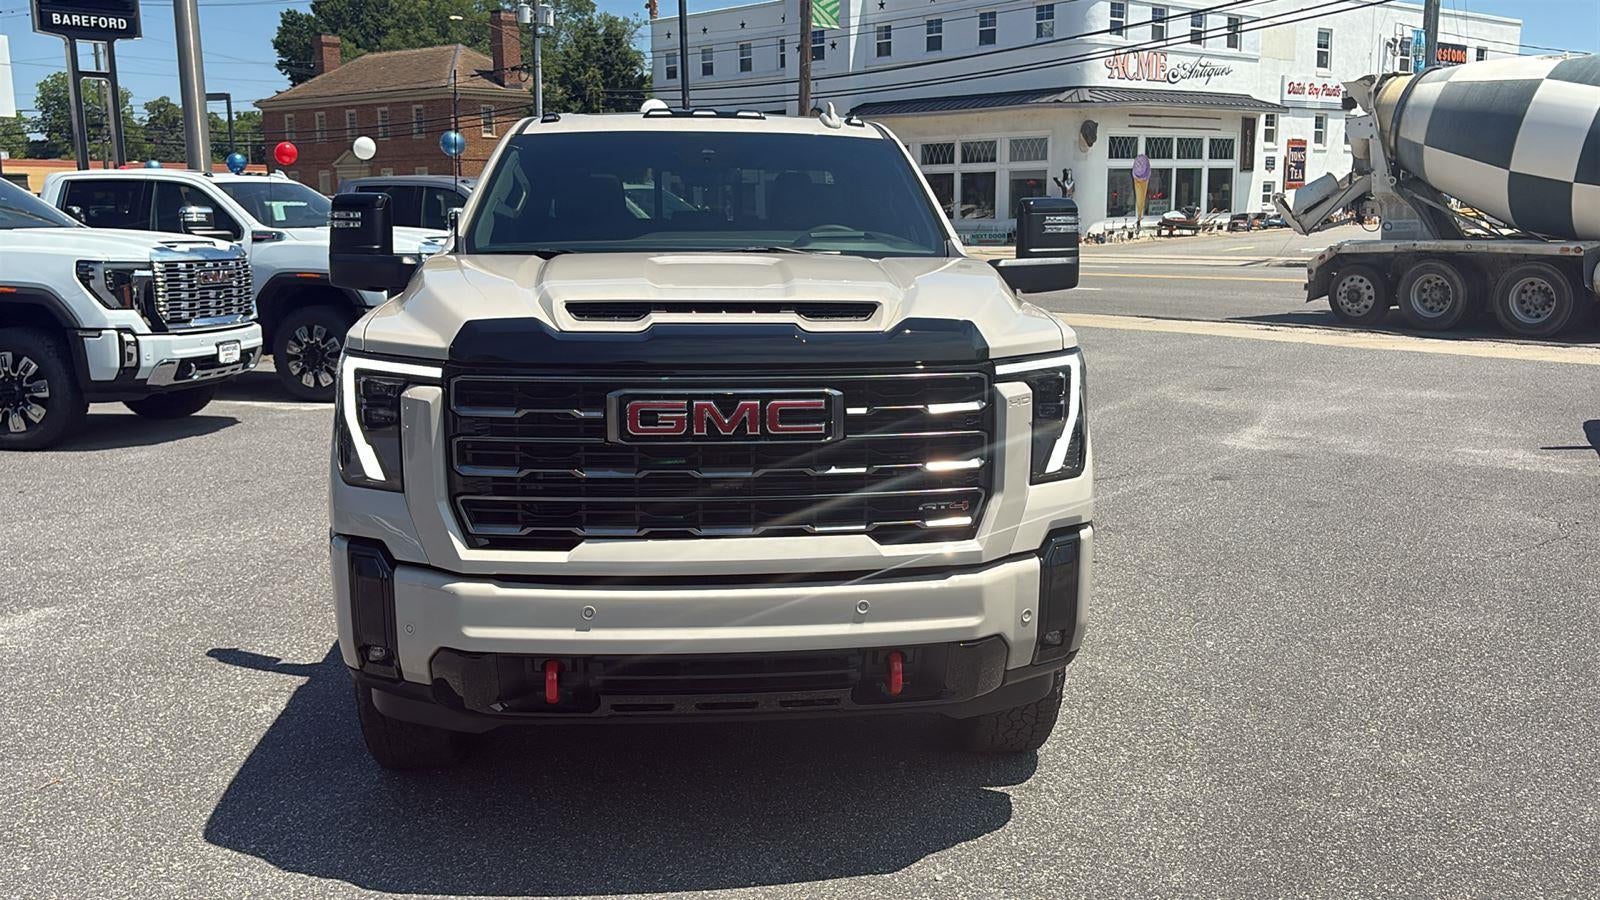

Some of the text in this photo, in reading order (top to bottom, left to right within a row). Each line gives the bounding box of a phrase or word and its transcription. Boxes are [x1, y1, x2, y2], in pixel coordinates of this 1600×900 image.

[52, 13, 127, 30] BAREFORD
[1436, 47, 1467, 63] estone
[1104, 49, 1168, 82] ACME
[1287, 81, 1341, 99] Dutch Boy Paints
[1289, 167, 1303, 179] TEA
[626, 400, 826, 436] GMC
